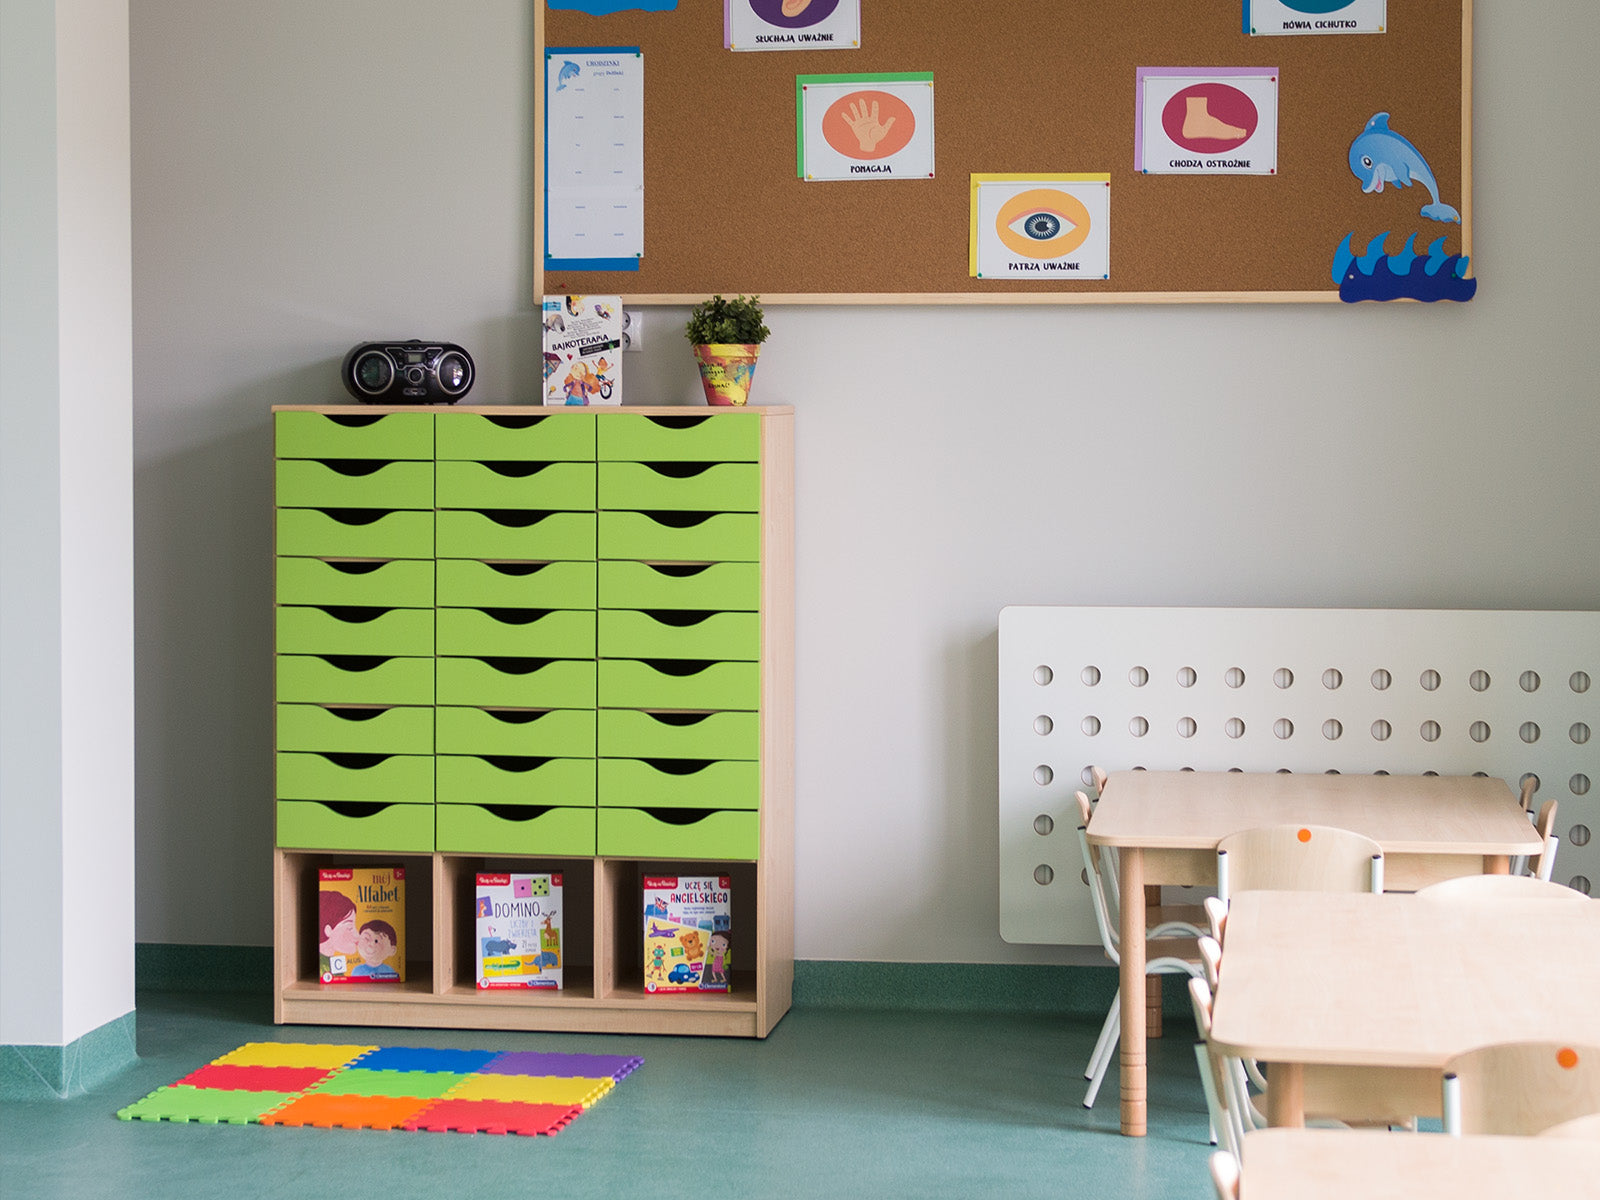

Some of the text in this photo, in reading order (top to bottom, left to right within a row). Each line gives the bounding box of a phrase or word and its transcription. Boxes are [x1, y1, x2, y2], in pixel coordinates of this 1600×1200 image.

[1282, 20, 1357, 30] MÓWIĄ CICHUTKO
[755, 32, 834, 43] SŁUCHAJĄ UWAŻNIE
[850, 164, 892, 174] POMAGAJĄ
[1169, 158, 1251, 169] CHODZĄ OSTROŻNIE
[1008, 261, 1080, 272] PATRZĄ UWAŻNIE
[685, 881, 701, 892] UCZĘ
[356, 884, 399, 903] Alfabet
[670, 893, 728, 903] ANGIELSKIEGO
[494, 900, 541, 919] DOMINO
[334, 958, 343, 971] C
